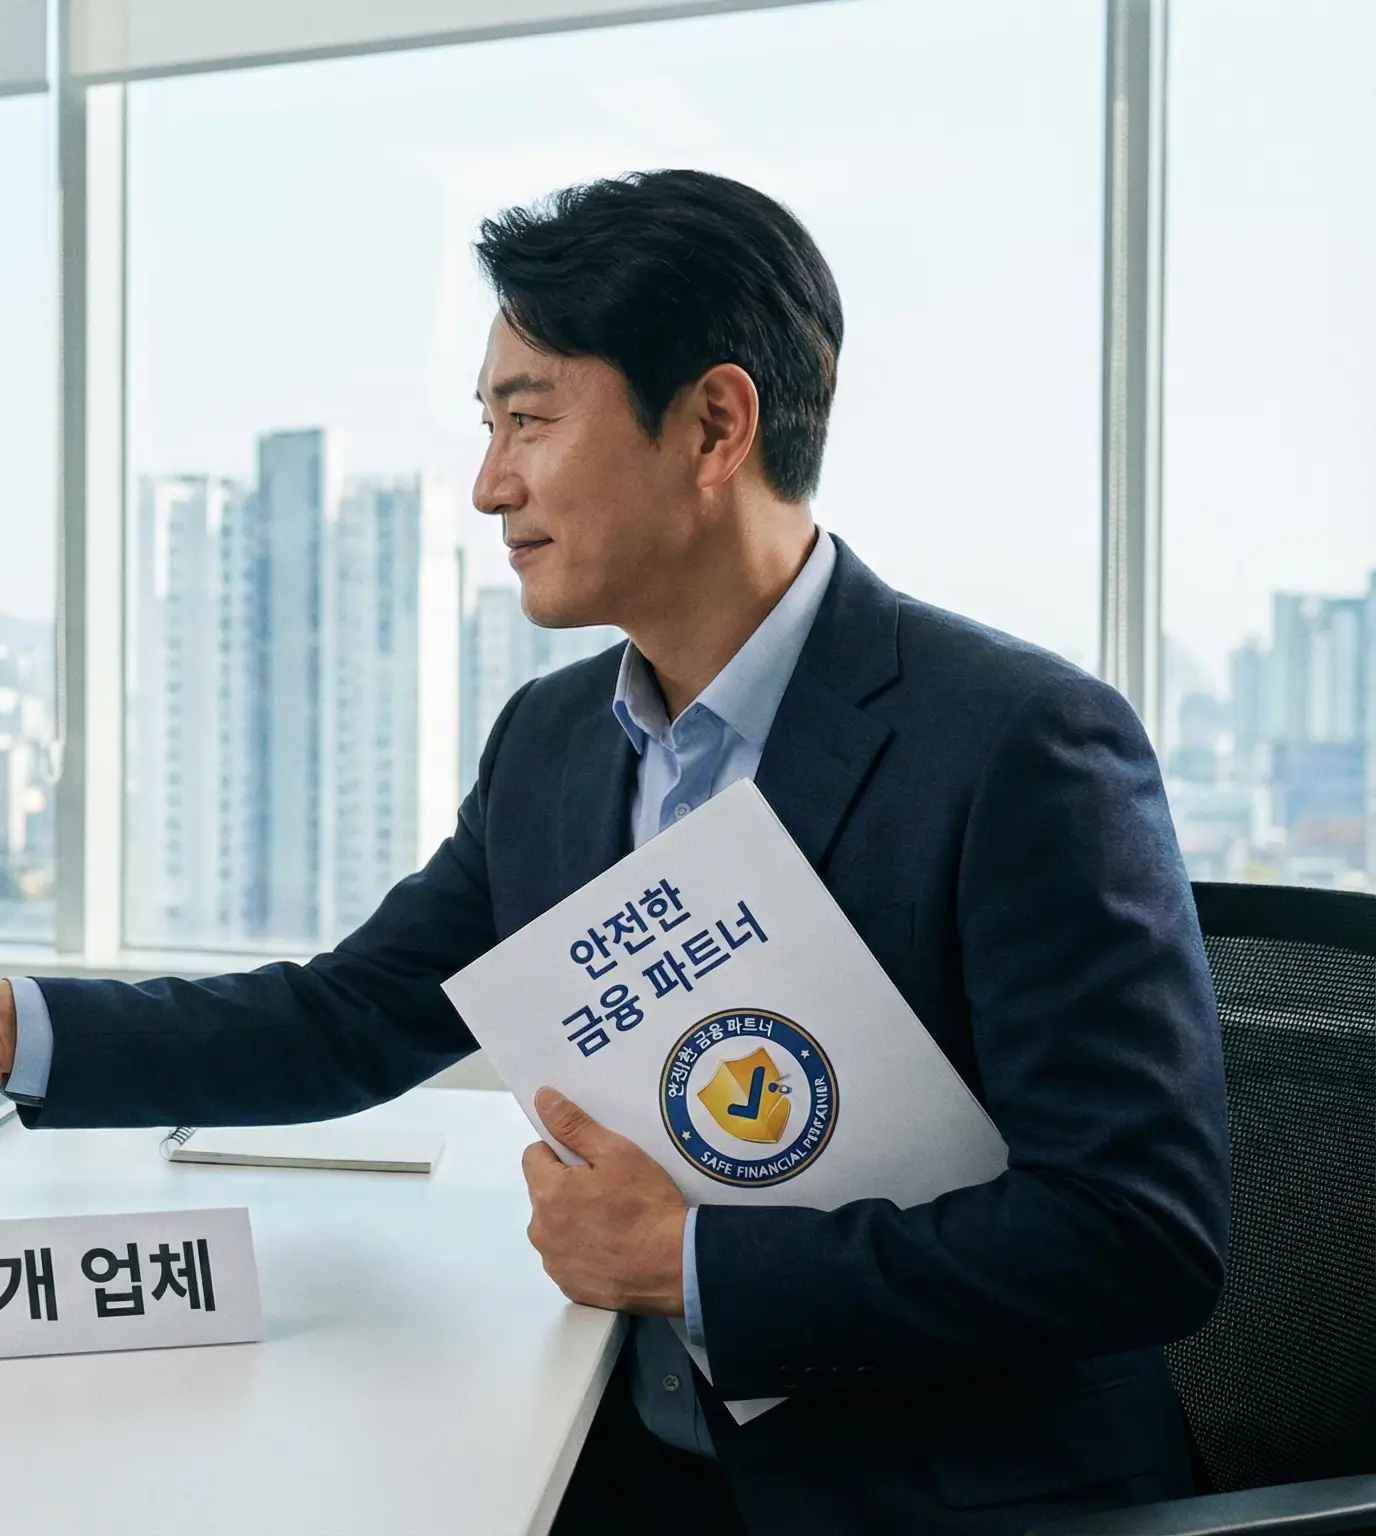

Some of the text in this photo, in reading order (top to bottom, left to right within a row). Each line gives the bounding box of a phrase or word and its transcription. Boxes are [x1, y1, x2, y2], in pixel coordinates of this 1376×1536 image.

[569, 878, 691, 980] 안전한
[561, 899, 769, 1058] 금융 파트너
[726, 1017, 773, 1037] 파트너
[700, 1151, 732, 1176] SAFE
[80, 1238, 217, 1318] 업체
